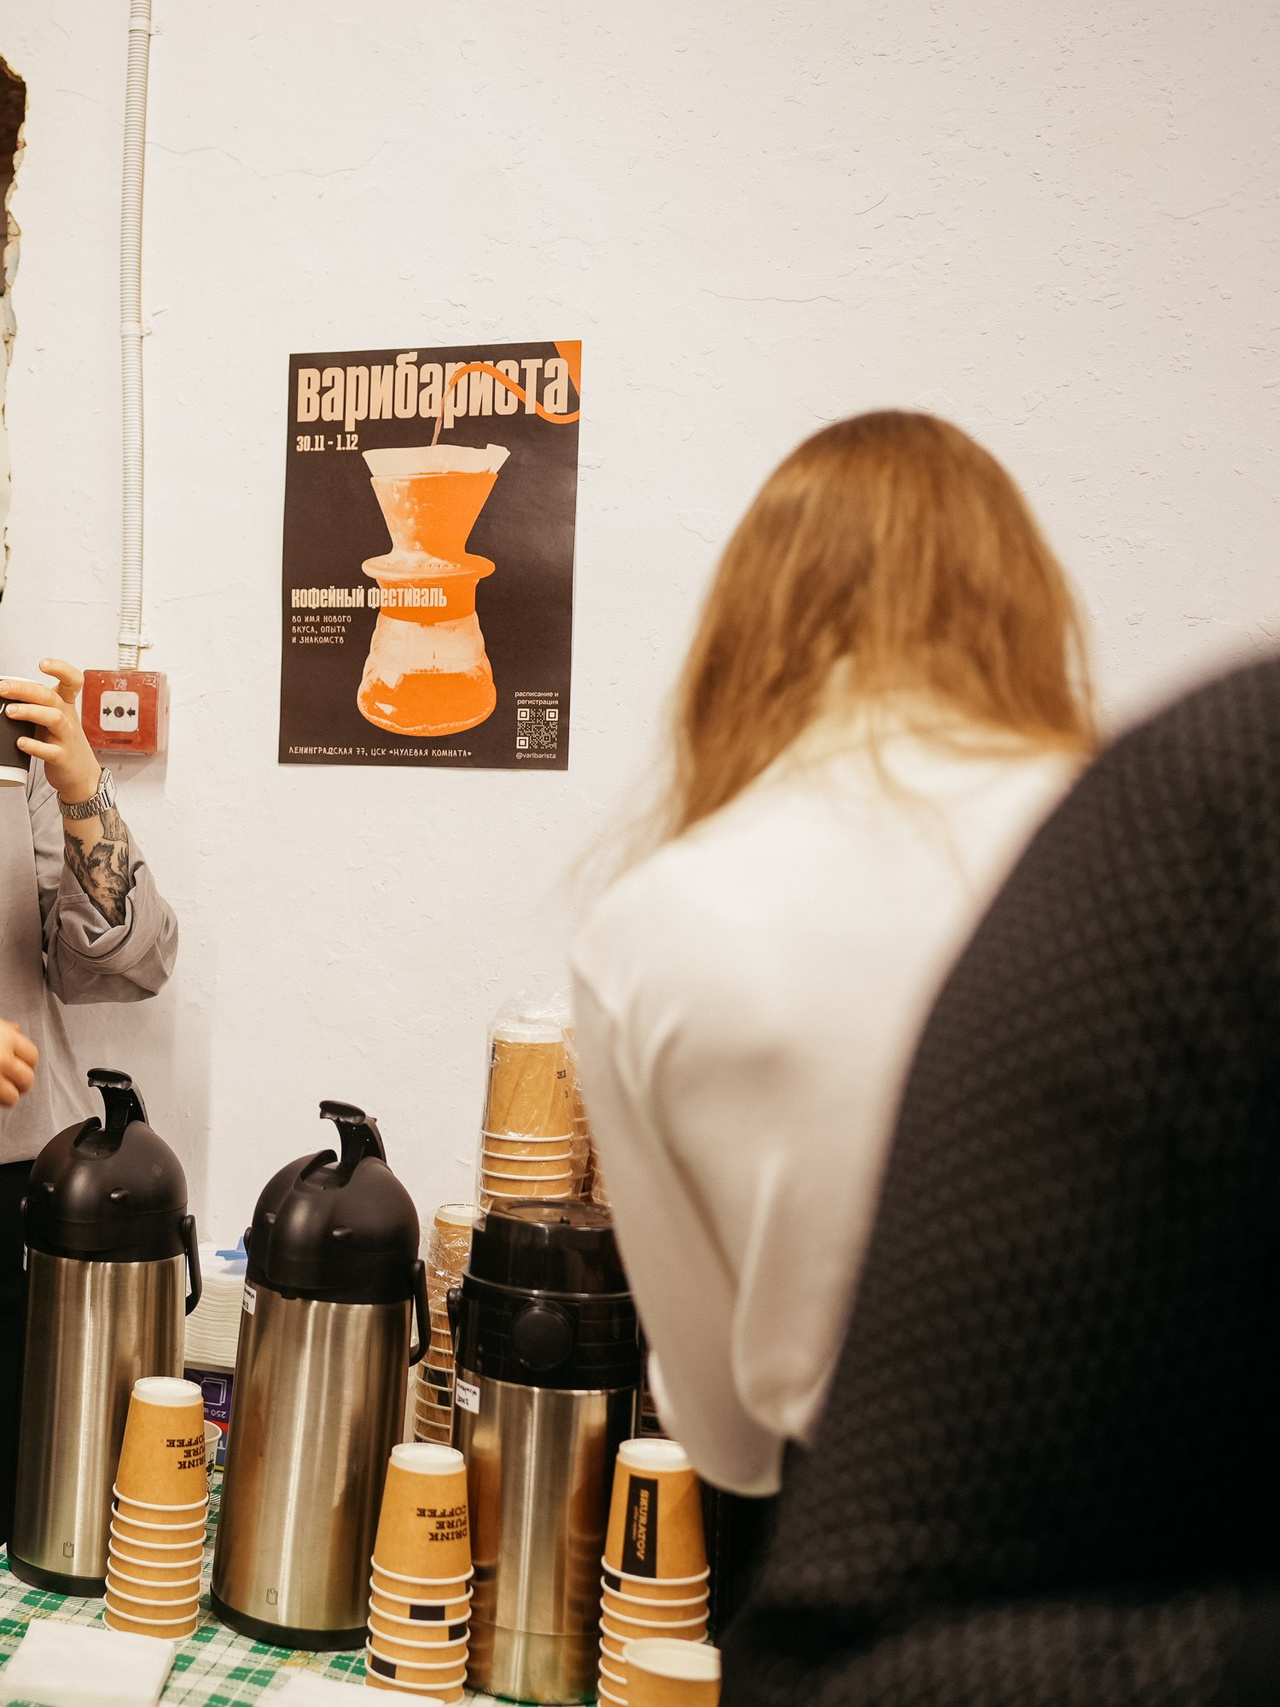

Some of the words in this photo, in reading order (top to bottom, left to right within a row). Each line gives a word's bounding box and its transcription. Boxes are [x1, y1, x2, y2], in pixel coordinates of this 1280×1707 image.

[296, 435, 325, 451] 30.11
[336, 434, 359, 450] 1.12
[299, 636, 344, 644] ЗНАКОМСТВ
[289, 746, 353, 755] ЛЕНИНГРАДСКАЯ
[370, 748, 387, 756] ЦСК
[389, 748, 429, 757] «НУЛЕВАЯ
[431, 749, 472, 757] КОМНАТА»
[210, 1409, 227, 1418] 250
[416, 1505, 466, 1518] COFFEE
[436, 1516, 467, 1530] PURE
[428, 1527, 467, 1541] DRINK
